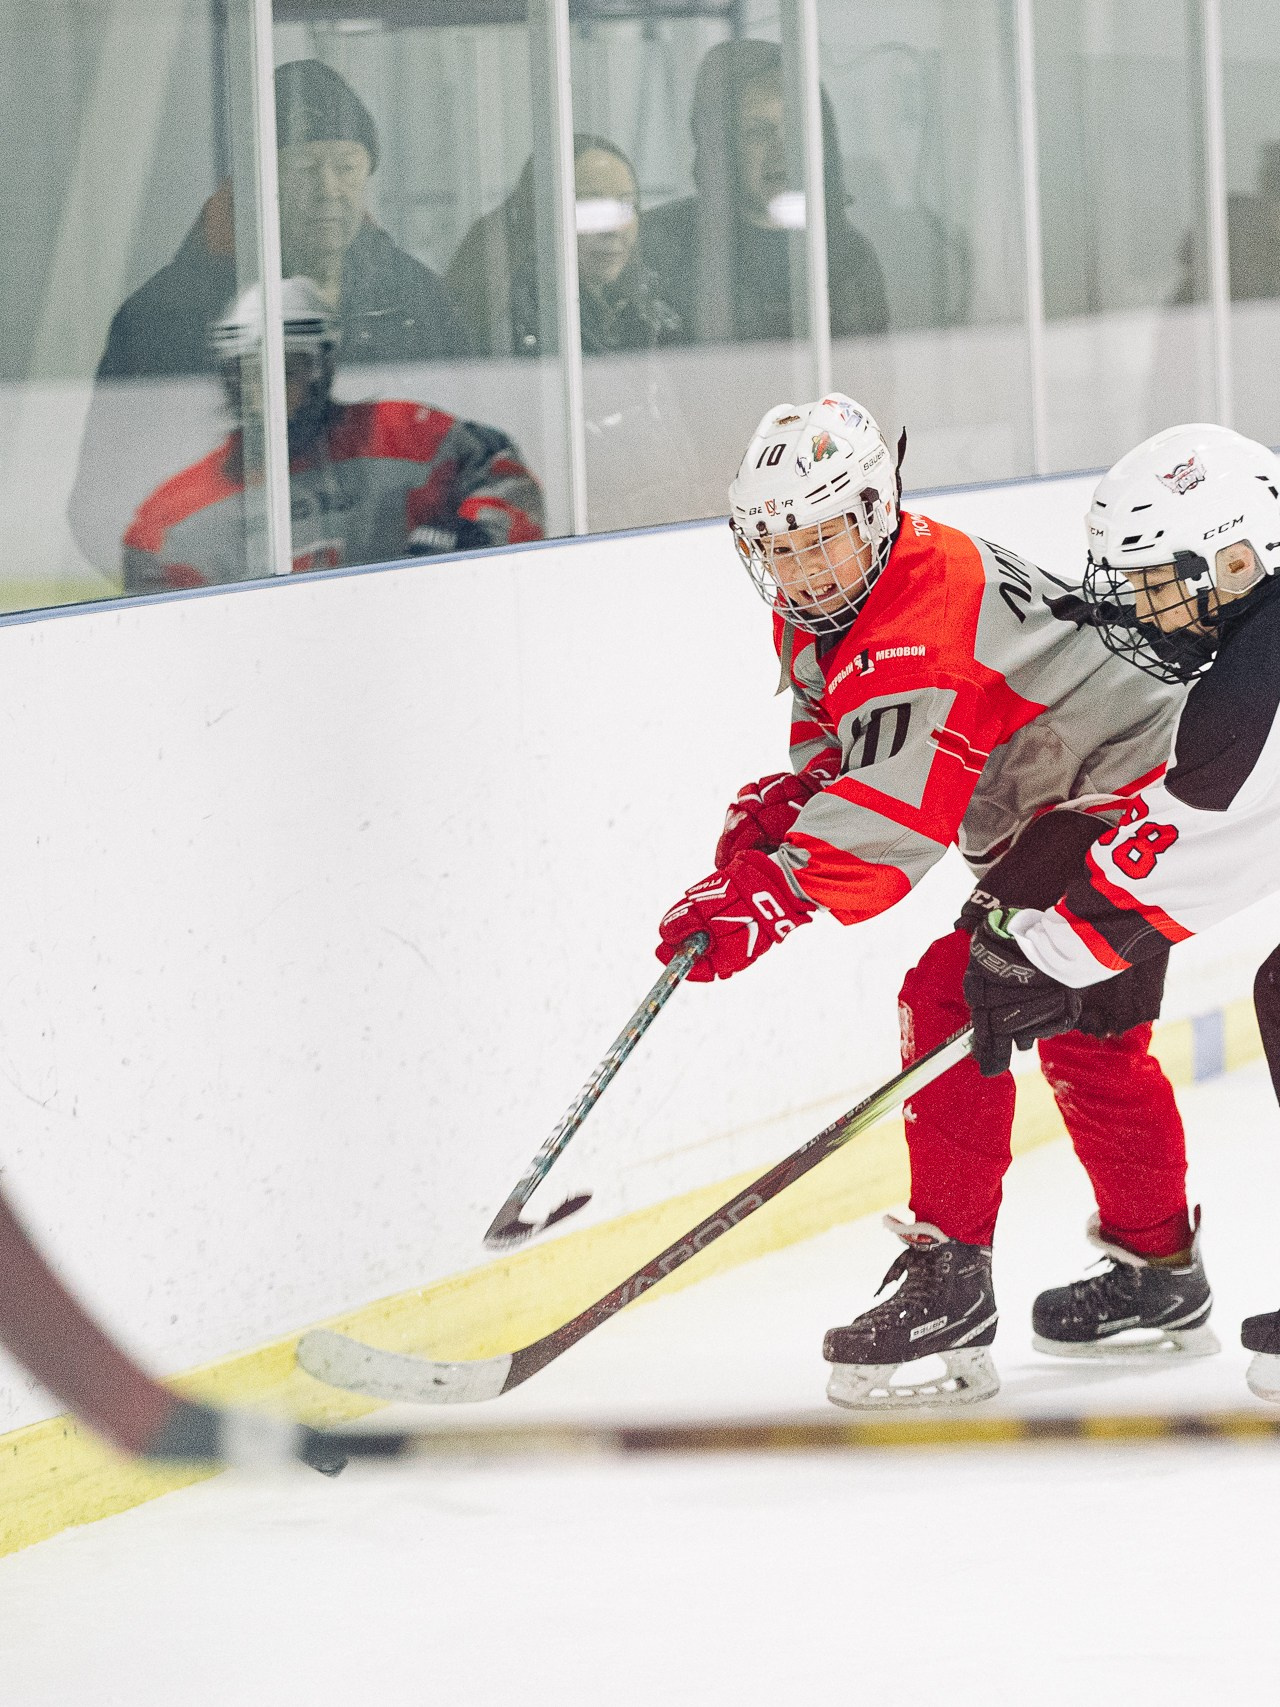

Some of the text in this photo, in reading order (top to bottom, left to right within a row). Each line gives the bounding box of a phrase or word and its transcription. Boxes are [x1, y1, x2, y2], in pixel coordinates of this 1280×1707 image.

[756, 444, 787, 469] 10
[1090, 527, 1104, 537] CM
[1203, 515, 1244, 540] CCM
[875, 644, 926, 661] МЕХОВОЙ
